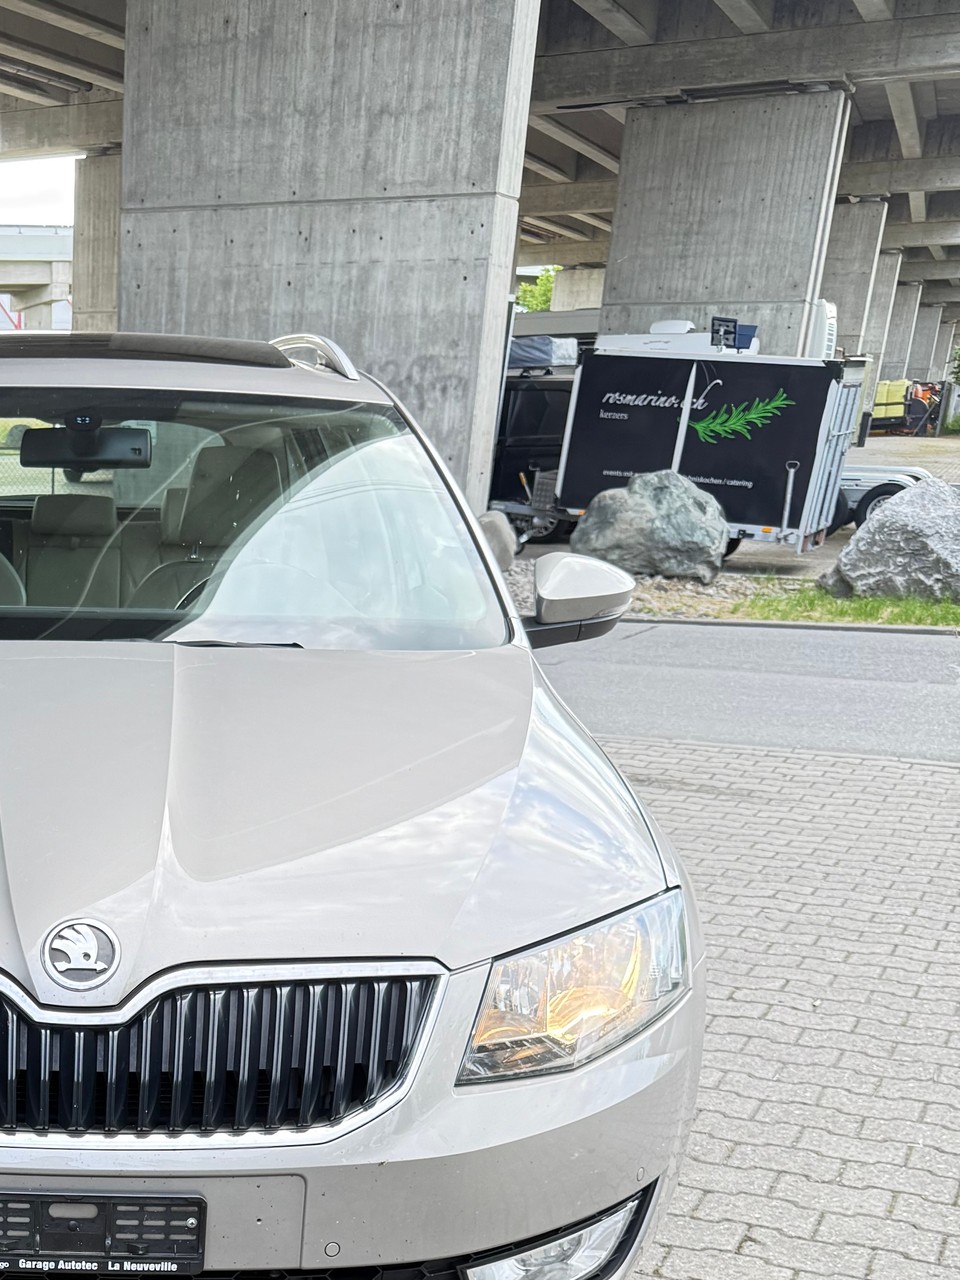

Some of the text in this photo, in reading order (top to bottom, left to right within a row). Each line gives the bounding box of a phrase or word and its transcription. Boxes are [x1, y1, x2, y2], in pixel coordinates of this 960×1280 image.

[602, 469, 622, 477] events
[727, 479, 754, 489] catering
[18, 1259, 55, 1270] Garage
[57, 1260, 99, 1271] Autotec
[107, 1260, 120, 1271] La
[123, 1261, 178, 1272] Neuveville
